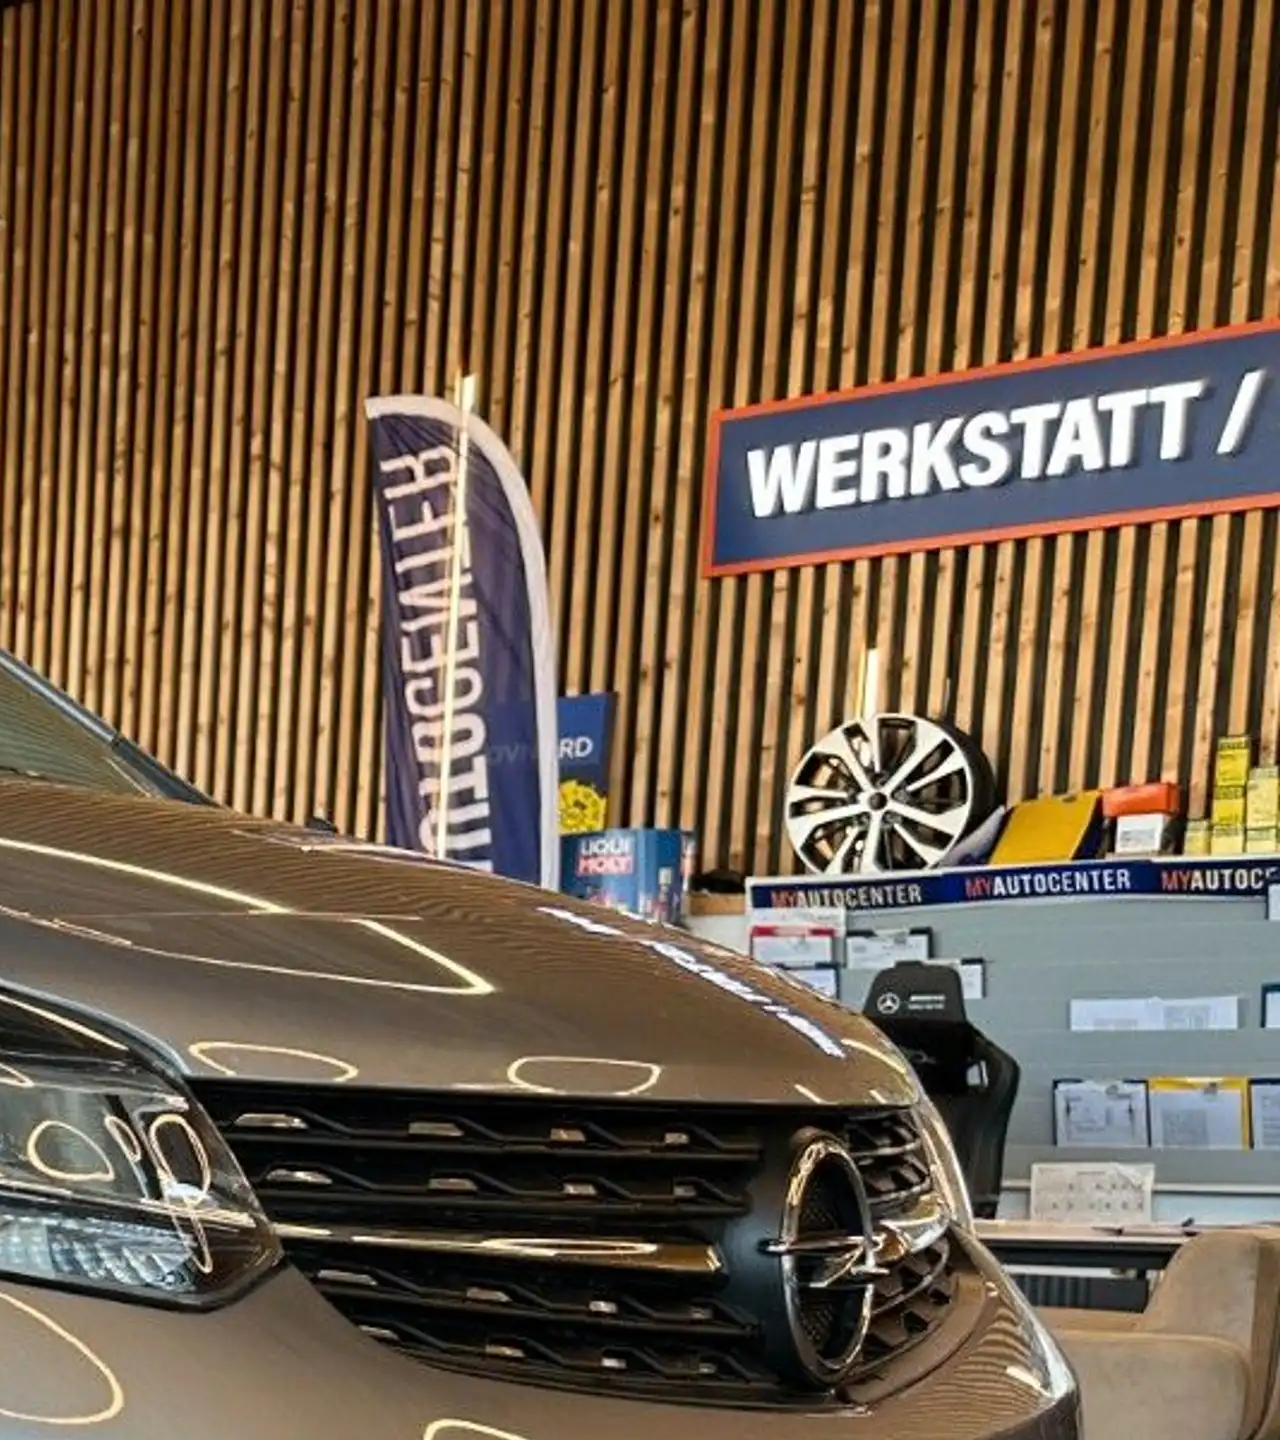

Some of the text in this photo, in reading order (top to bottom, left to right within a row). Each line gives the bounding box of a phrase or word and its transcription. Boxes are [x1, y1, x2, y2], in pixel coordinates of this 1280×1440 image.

[746, 367, 1266, 518] WERKSTATT /
[771, 883, 922, 909] MYAUTOCENTER
[965, 867, 1131, 898] MYAUTOCENTER
